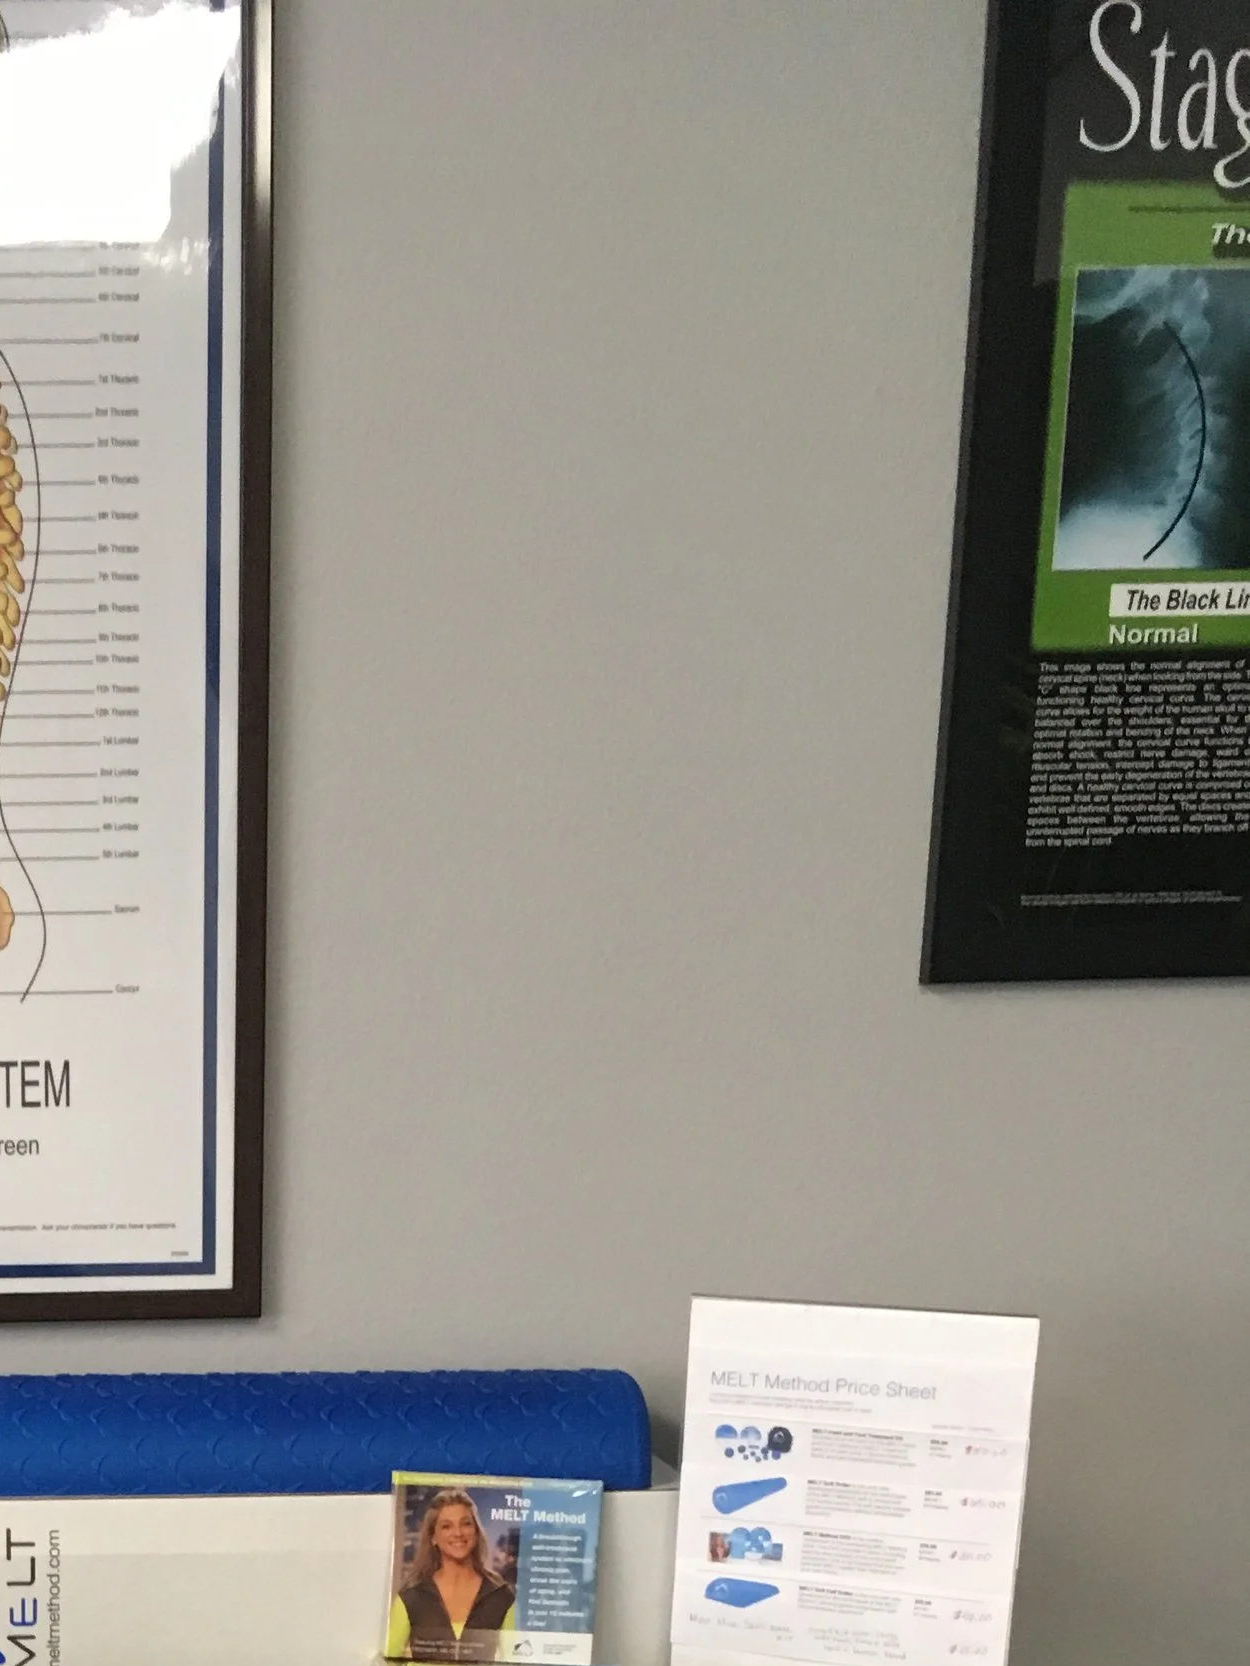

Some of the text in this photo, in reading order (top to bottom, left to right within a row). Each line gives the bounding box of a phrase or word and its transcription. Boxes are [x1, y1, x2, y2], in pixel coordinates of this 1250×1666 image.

[1128, 589, 1161, 612] The
[1166, 588, 1220, 611] Black
[1109, 623, 1199, 645] Normal
[710, 1371, 938, 1401] MELT Method Price Sheet
[505, 1495, 532, 1508] The
[491, 1508, 587, 1524] MELT Method
